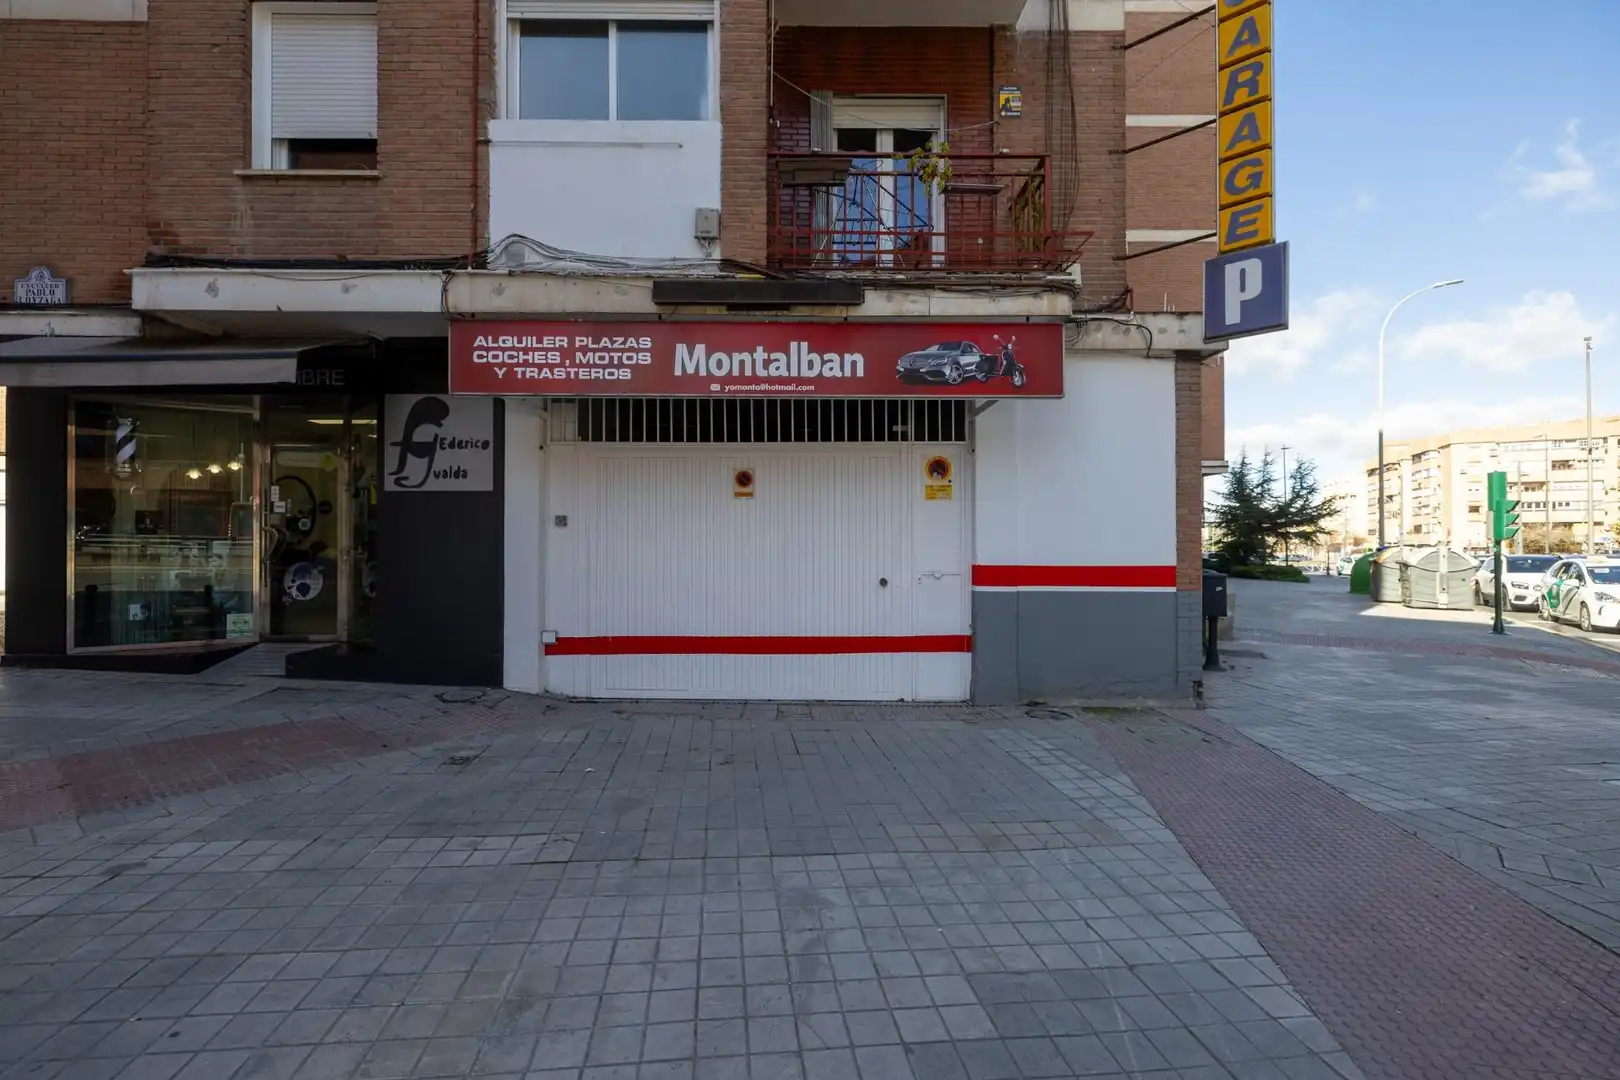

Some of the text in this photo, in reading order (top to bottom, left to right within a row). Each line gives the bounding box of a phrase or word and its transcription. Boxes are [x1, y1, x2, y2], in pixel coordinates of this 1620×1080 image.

[1223, 0, 1264, 245] ARAGE
[25, 288, 56, 297] PABLO
[1224, 257, 1263, 326] P
[473, 335, 652, 348] ALQUILER PLAZAS
[575, 352, 652, 365] MOTOS
[674, 341, 864, 378] Montalban
[494, 367, 632, 380] Y TRASTEROS
[724, 383, 815, 392] yomonta@hotmail.com
